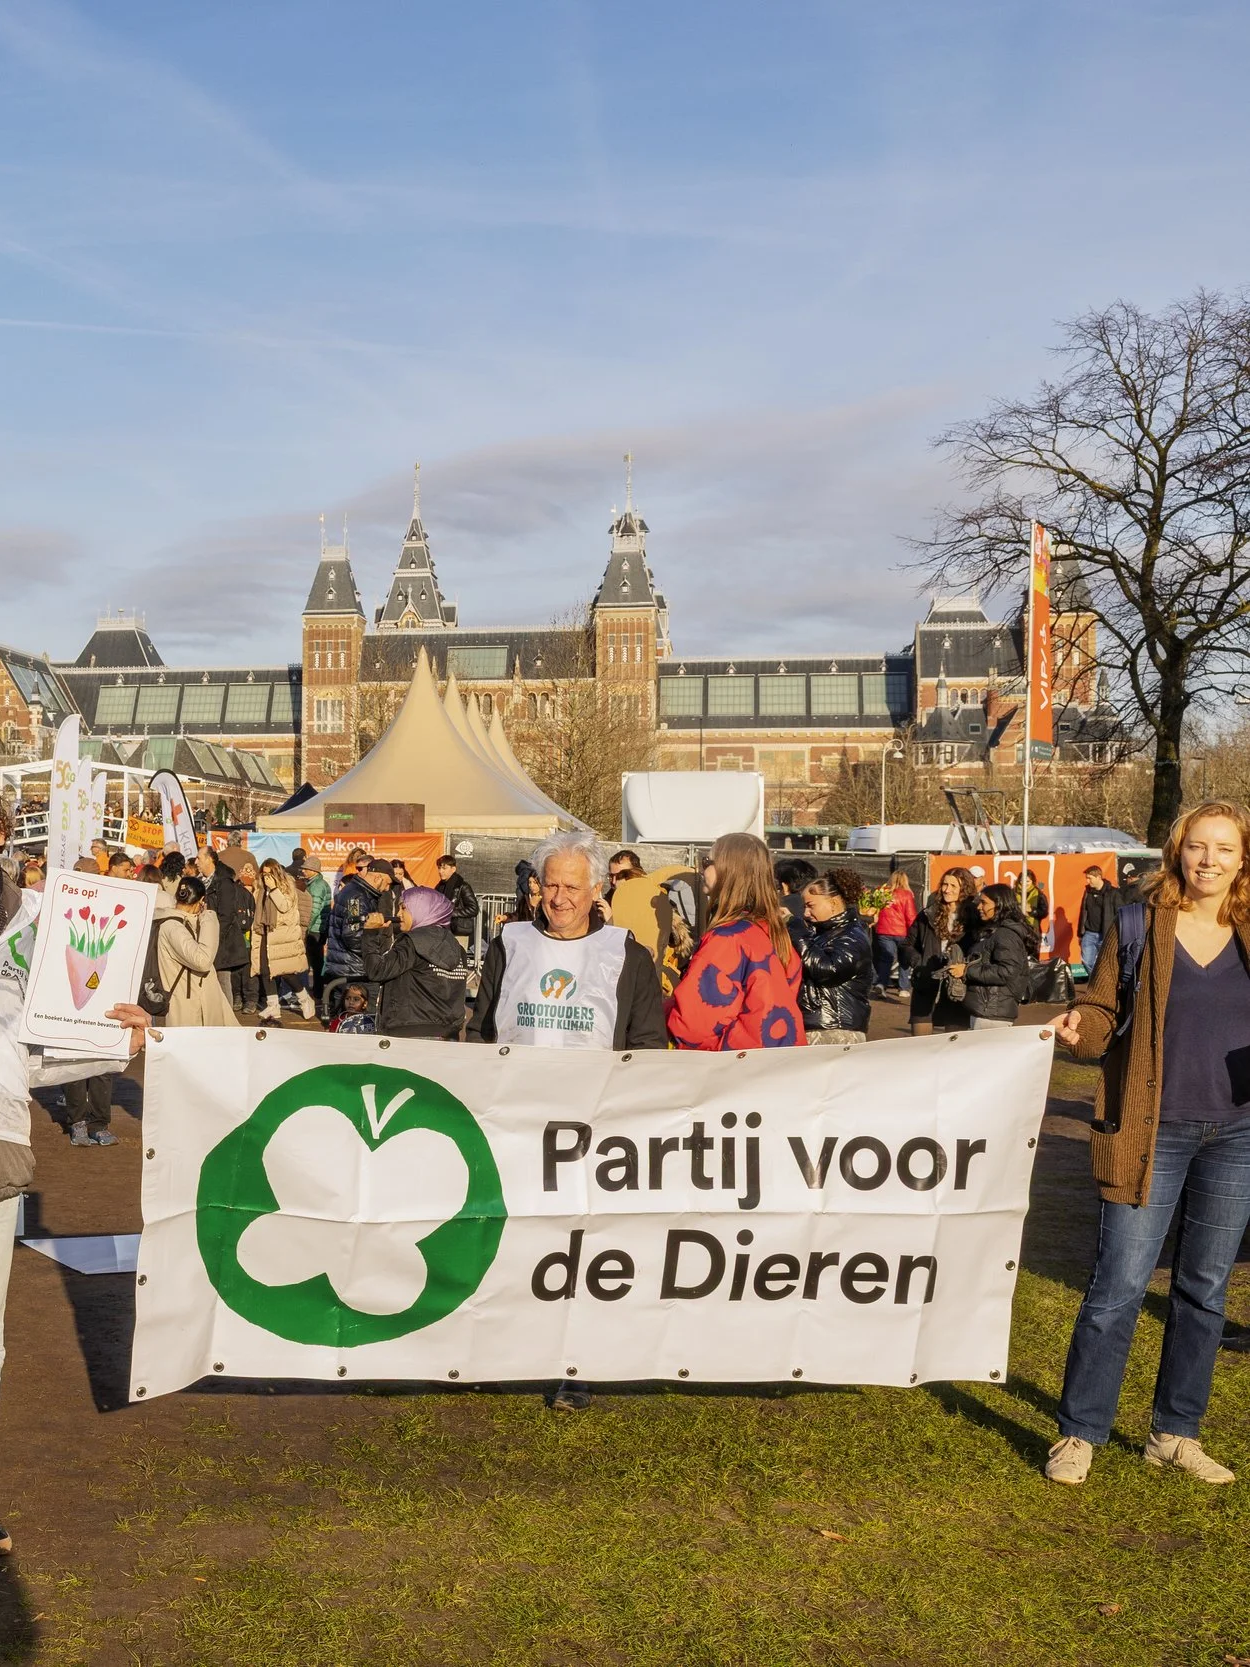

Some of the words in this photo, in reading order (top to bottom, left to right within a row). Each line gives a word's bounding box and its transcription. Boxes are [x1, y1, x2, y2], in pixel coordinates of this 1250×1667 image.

[143, 826, 162, 835] STOP
[307, 838, 376, 852] Welkom!
[61, 883, 79, 895] Pas
[81, 888, 98, 899] op!
[2, 960, 26, 977] Partij
[517, 1002, 595, 1020] GROOTOUDERS
[97, 1021, 120, 1029] bevatten
[516, 1016, 535, 1027] VOOR
[538, 1017, 554, 1029] HET
[556, 1019, 594, 1032] KLIMAAT
[542, 1111, 762, 1210] Partij
[787, 1136, 987, 1191] voor
[531, 1229, 635, 1302] de
[659, 1229, 938, 1305] Dieren
